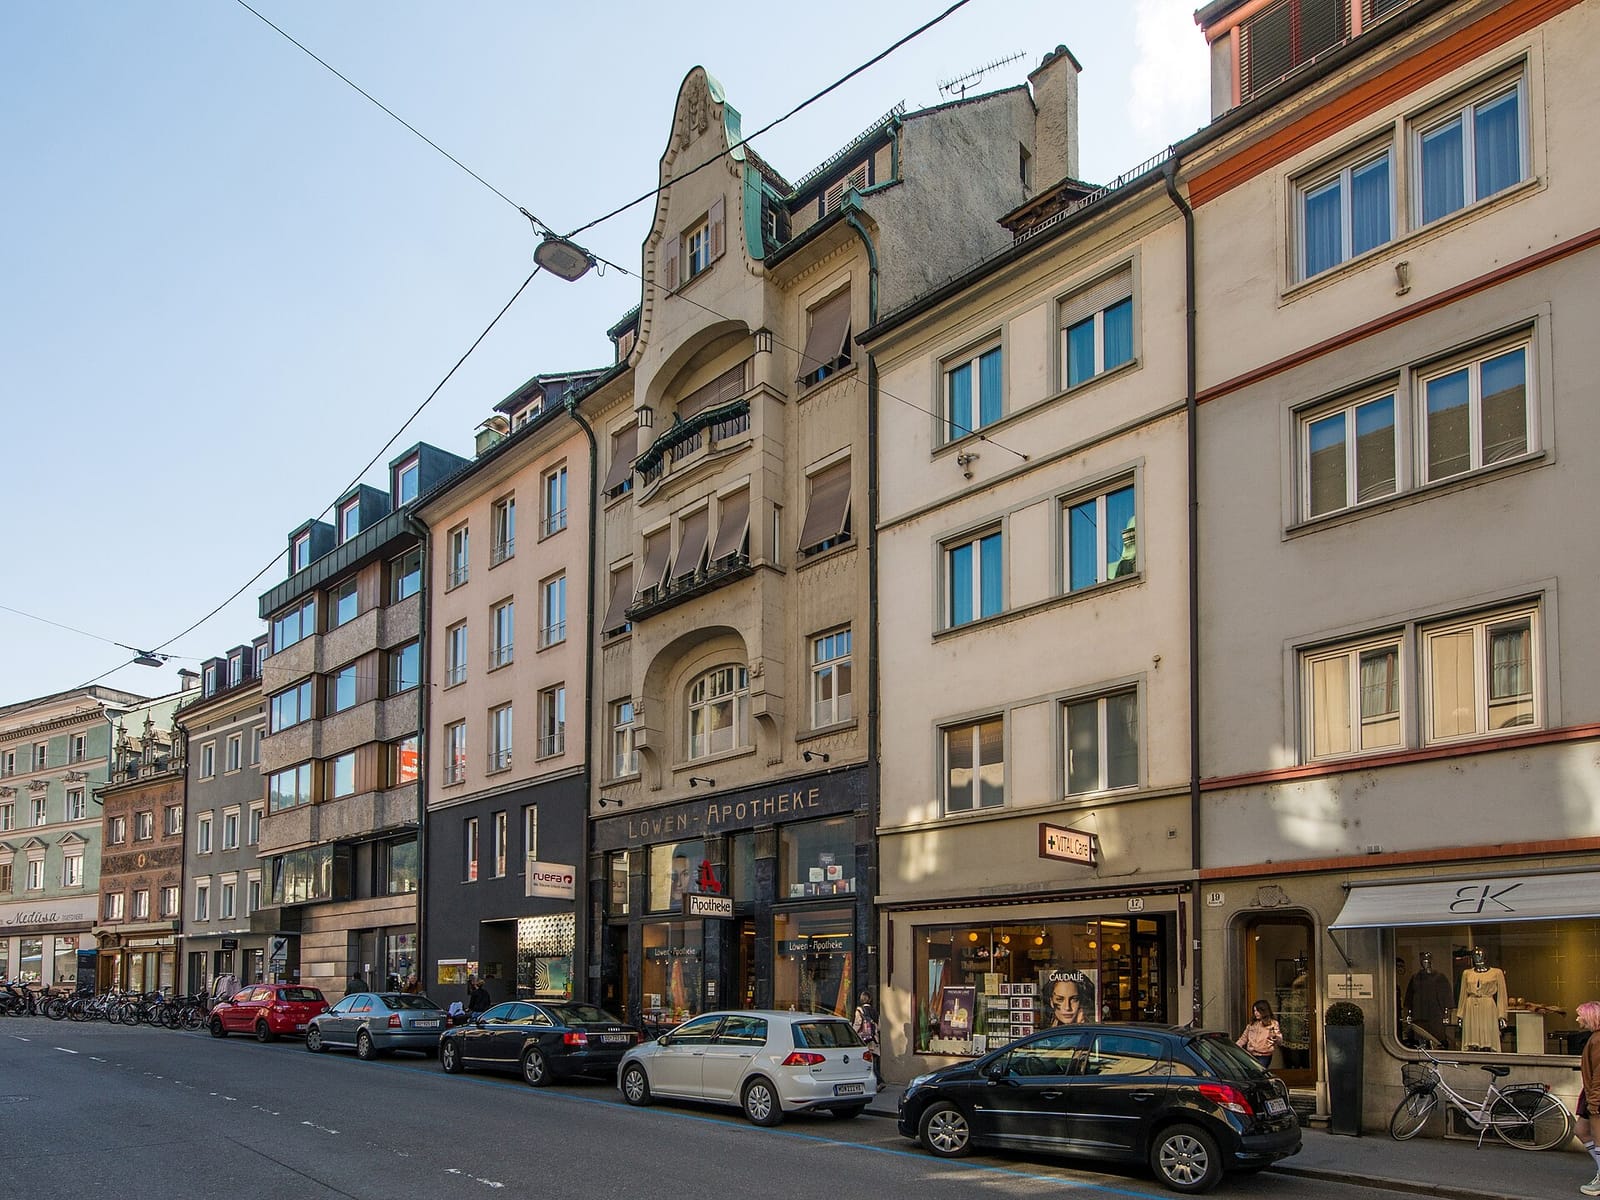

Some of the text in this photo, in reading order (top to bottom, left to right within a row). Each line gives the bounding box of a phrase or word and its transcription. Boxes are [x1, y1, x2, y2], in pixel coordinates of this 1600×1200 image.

[1055, 834, 1088, 856] VITAL Care
[533, 872, 562, 883] ruefa
[1211, 893, 1220, 901] 19
[692, 897, 731, 914] Apotheke
[1131, 899, 1140, 907] 17
